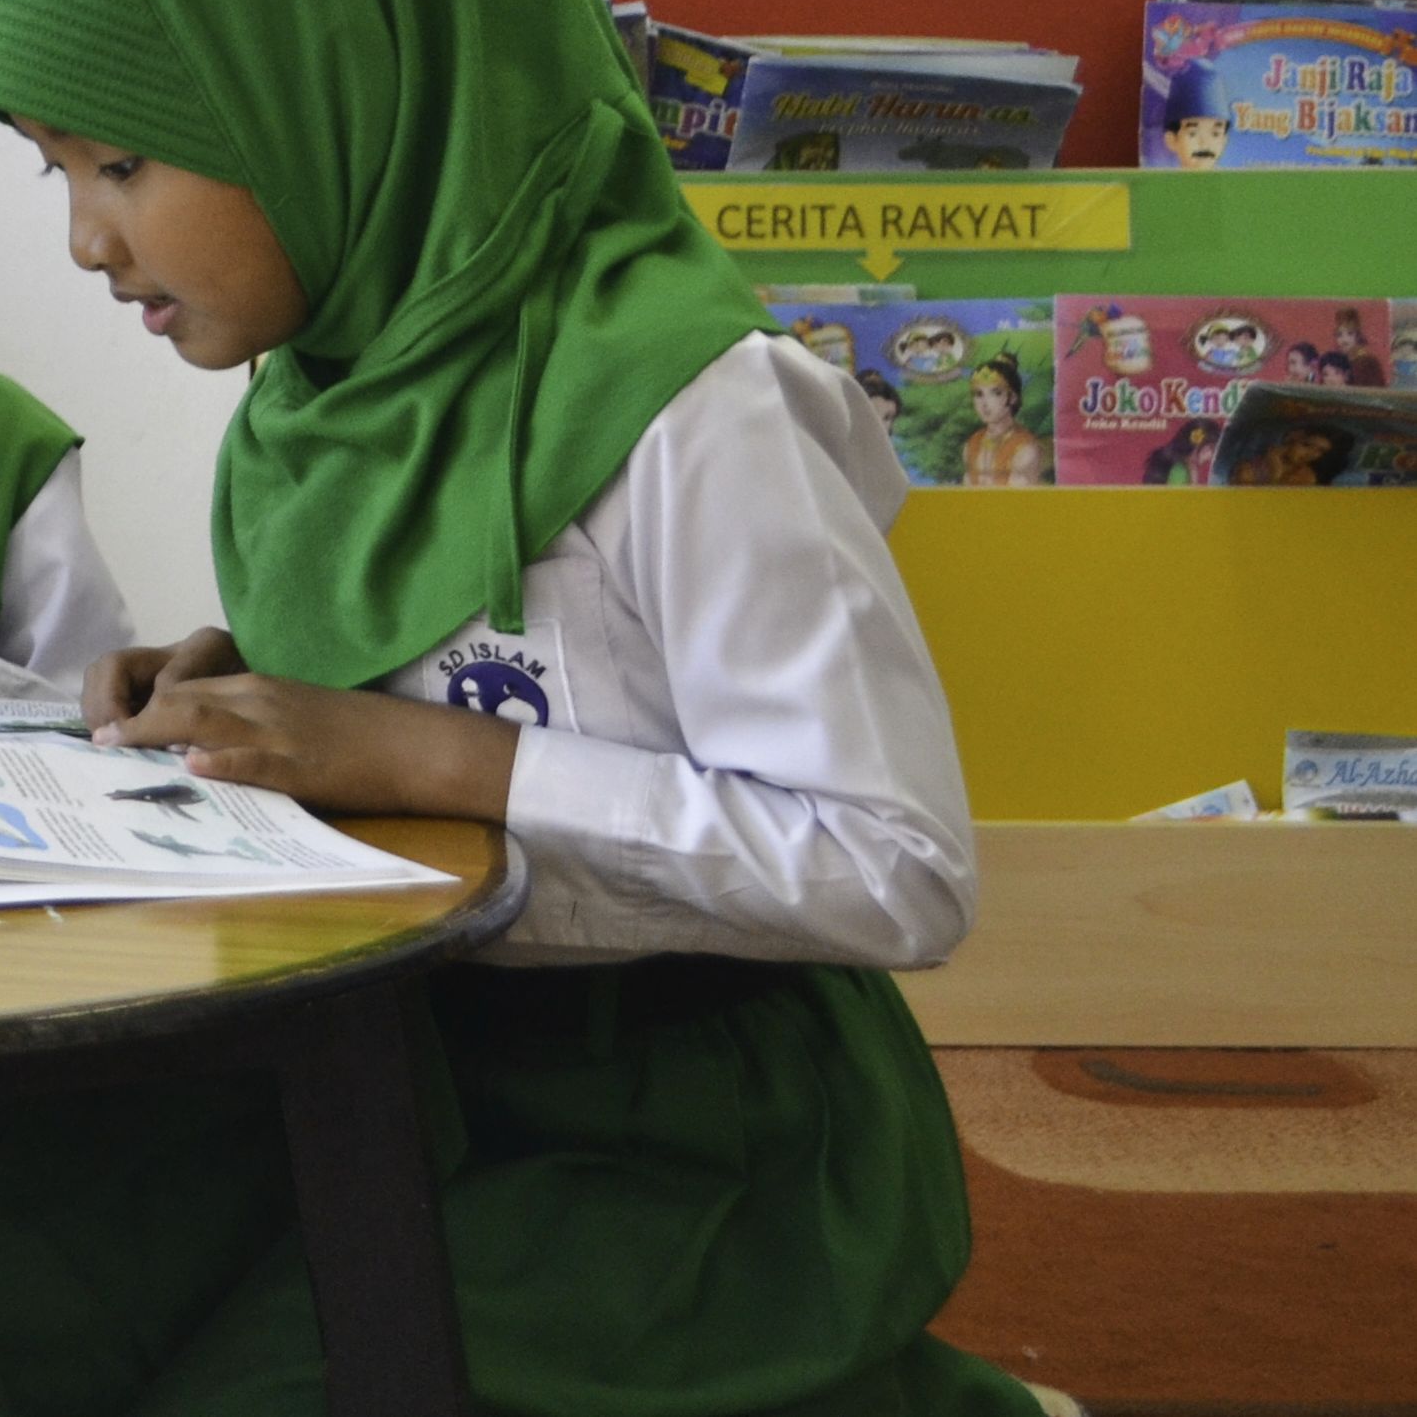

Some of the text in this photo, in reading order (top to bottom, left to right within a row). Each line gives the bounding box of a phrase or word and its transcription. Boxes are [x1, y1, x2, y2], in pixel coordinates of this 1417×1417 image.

[1262, 54, 1414, 103] Janji Raja
[1232, 102, 1292, 139] Yang
[716, 203, 1046, 239] CERITA RAKYAT
[1079, 375, 1160, 420] Joko
[438, 642, 547, 680] SD ISLAM
